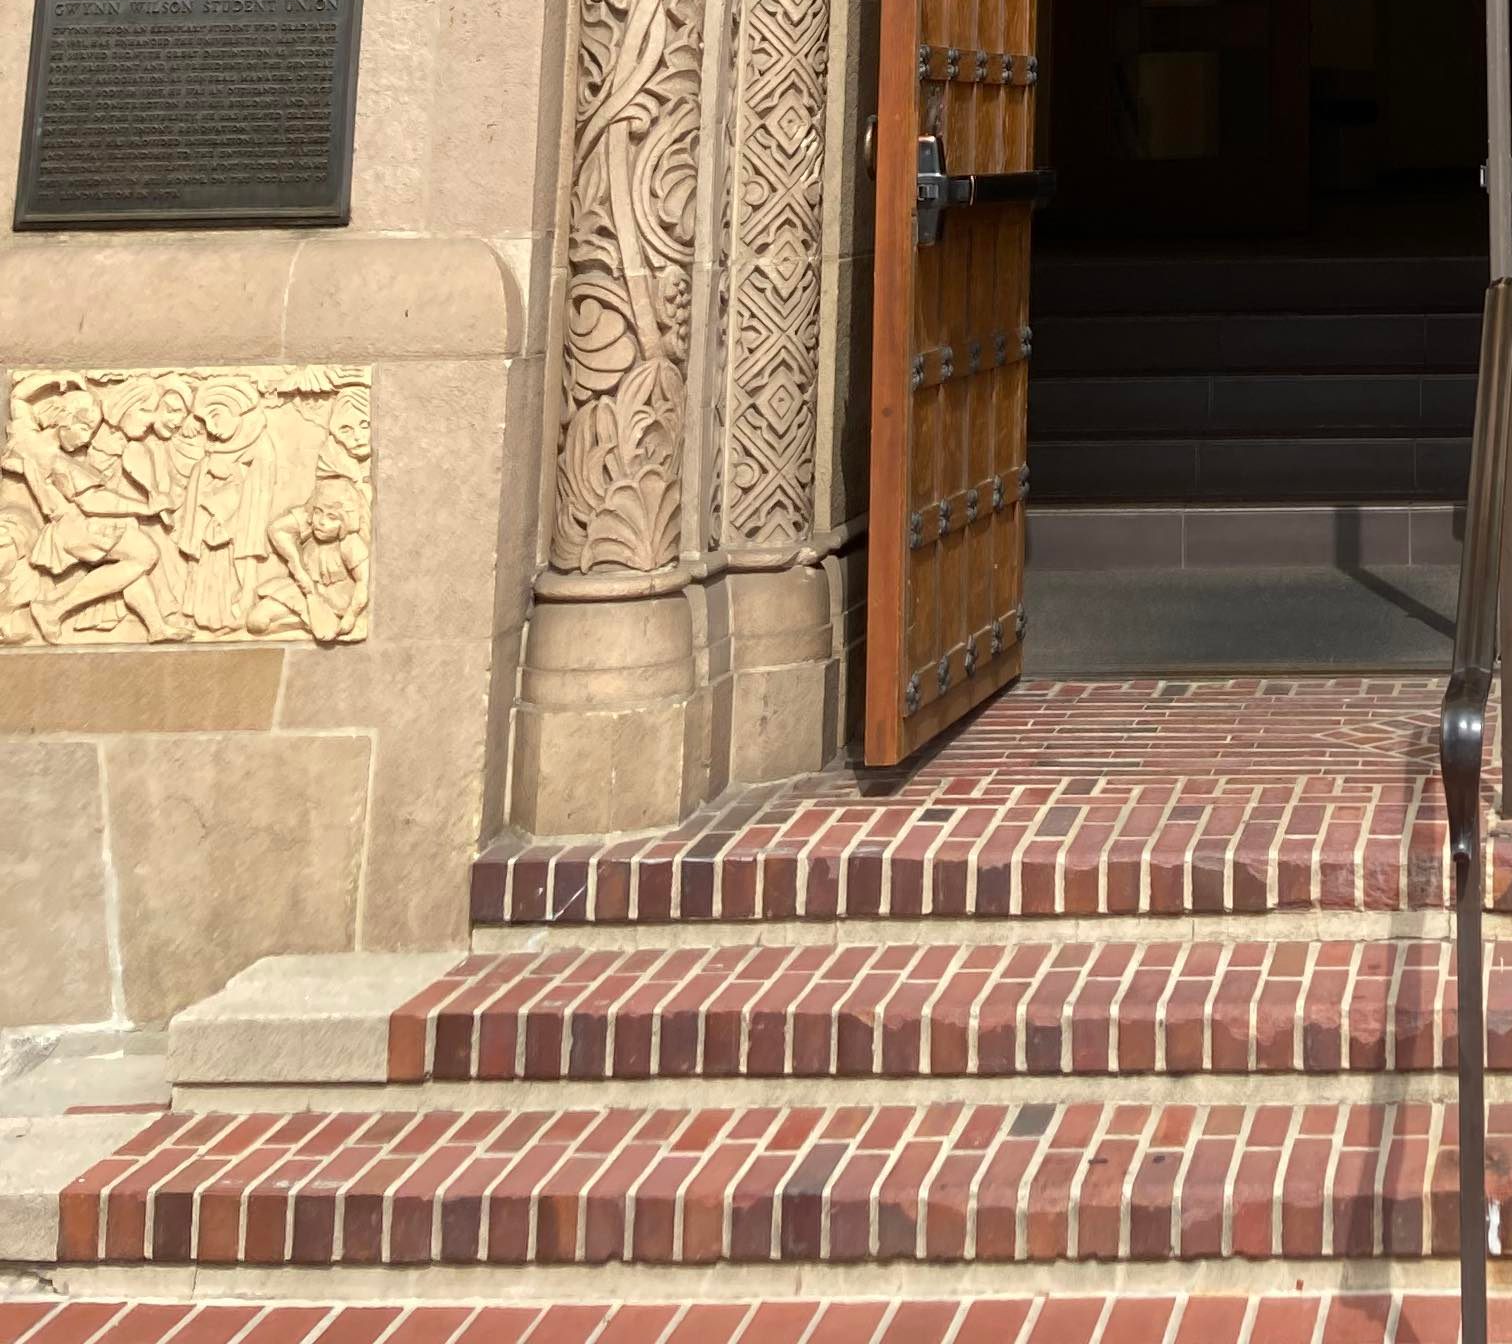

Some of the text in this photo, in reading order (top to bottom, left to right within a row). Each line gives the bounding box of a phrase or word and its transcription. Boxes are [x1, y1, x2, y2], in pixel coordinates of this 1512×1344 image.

[54, 1, 120, 17] GWYNN
[129, 0, 194, 15] WILSON
[202, 0, 277, 13] STUDENT
